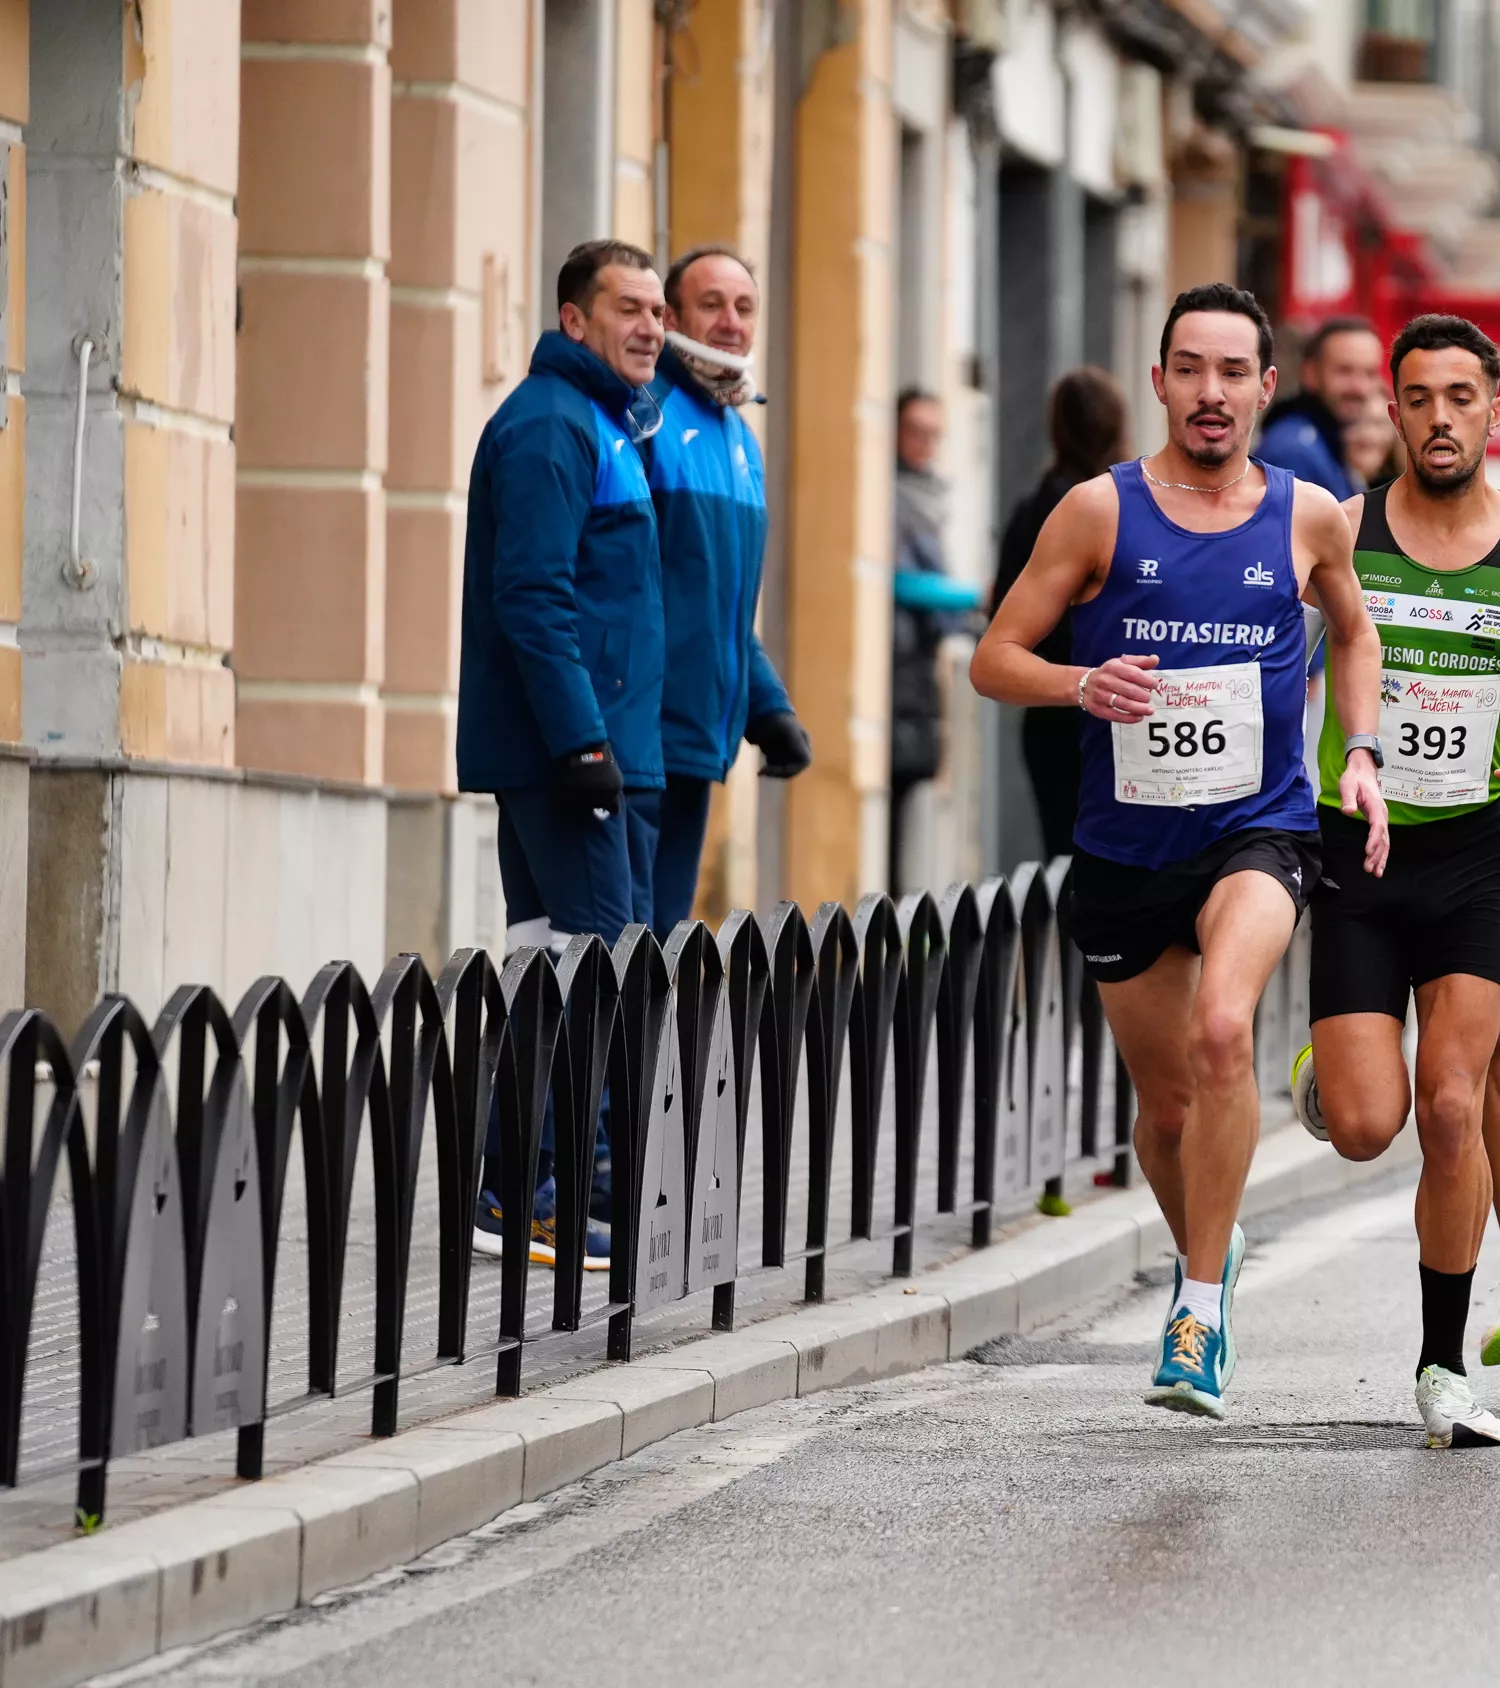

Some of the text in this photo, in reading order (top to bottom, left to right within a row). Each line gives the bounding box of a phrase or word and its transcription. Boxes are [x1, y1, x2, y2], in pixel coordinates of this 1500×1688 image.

[1243, 561, 1274, 586] als
[1369, 573, 1402, 585] IMDECO
[1475, 587, 1489, 598] LSC
[1365, 603, 1394, 615] RDOBA
[1122, 617, 1276, 646] TROTASIERRA
[1381, 645, 1424, 666] TISMO
[1166, 694, 1214, 707] LUCENA
[1421, 698, 1464, 713] LUCENA
[1149, 720, 1226, 757] 586
[1398, 722, 1467, 760] 393
